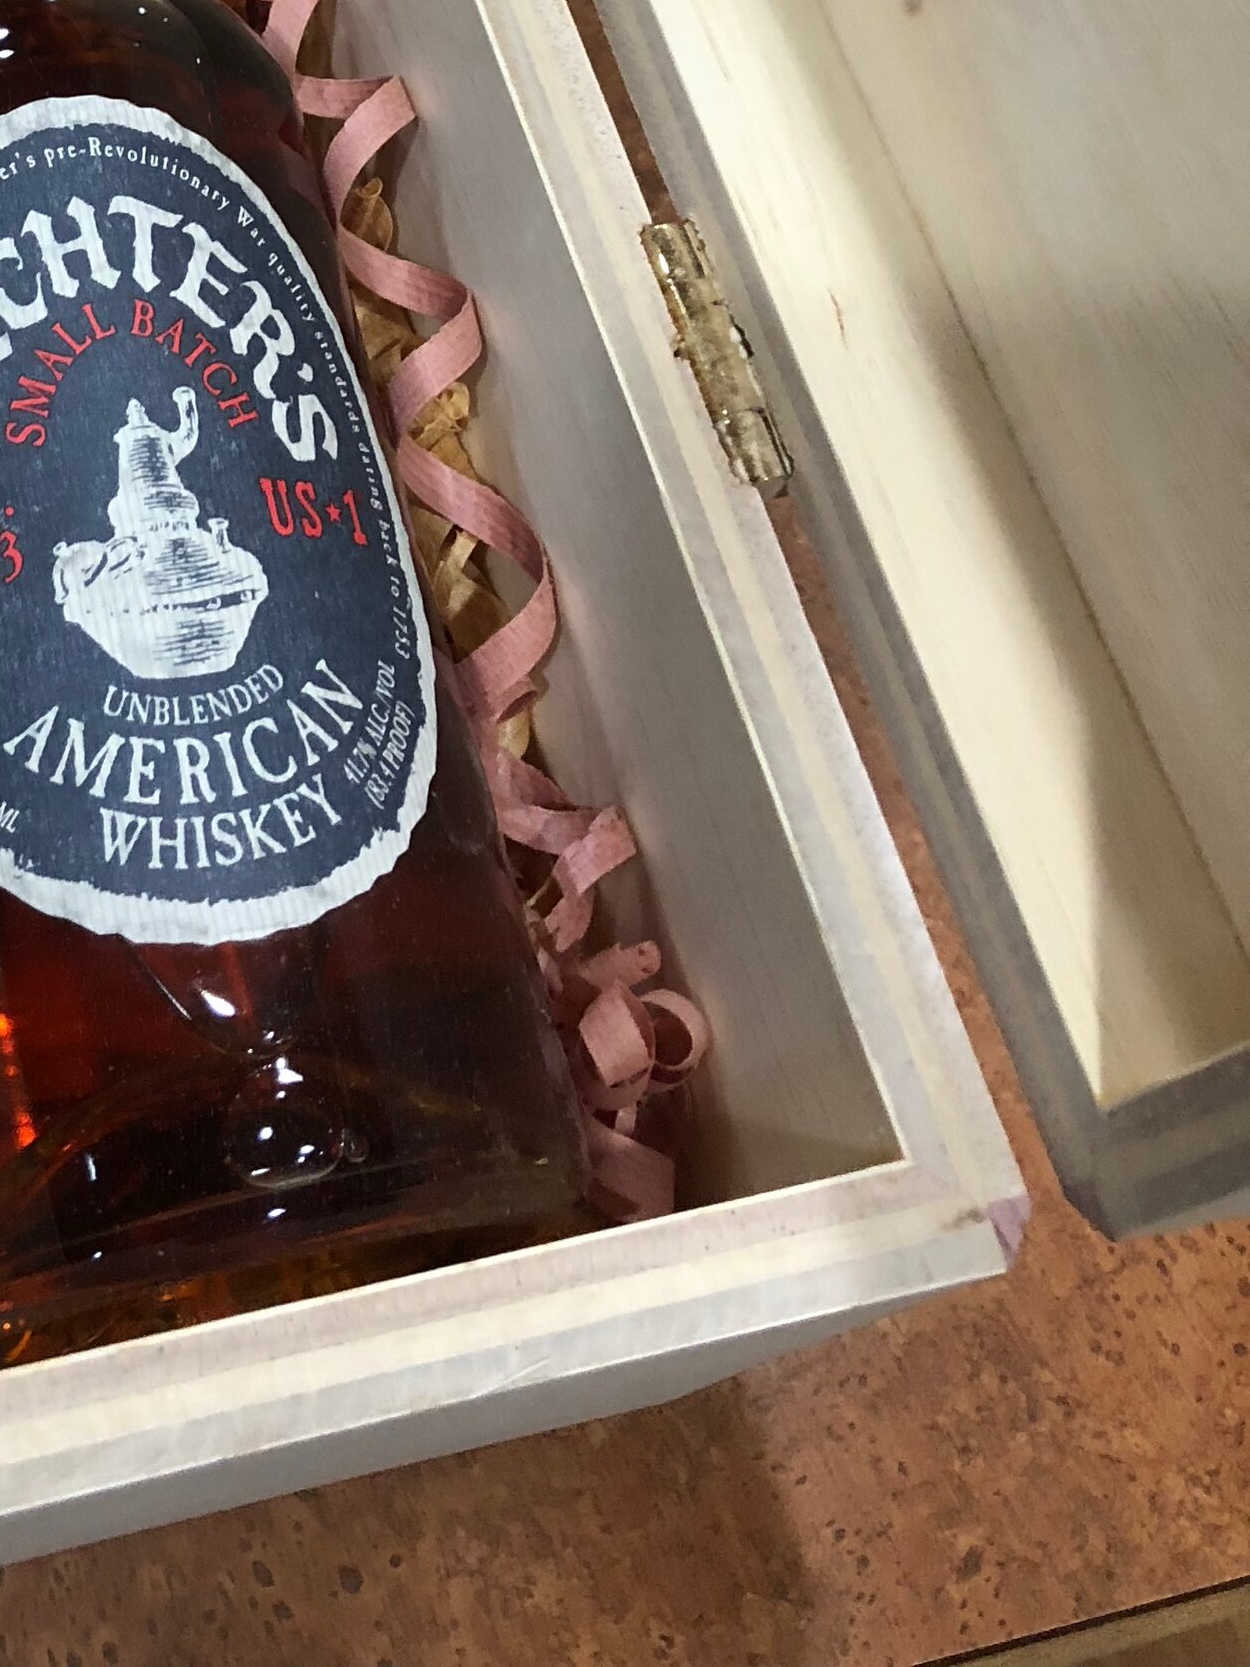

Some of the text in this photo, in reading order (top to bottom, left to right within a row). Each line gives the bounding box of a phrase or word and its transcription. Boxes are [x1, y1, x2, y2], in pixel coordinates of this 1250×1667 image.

[43, 135, 231, 212] pre-Revolutionary
[236, 205, 266, 248] War
[267, 251, 317, 324] quality
[6, 296, 259, 448] SMALL BATCH
[314, 329, 361, 434] standards
[357, 440, 385, 511] dating
[378, 518, 398, 568] back
[389, 572, 401, 599] to
[392, 602, 410, 661] 1753
[103, 662, 285, 726] UNBLENDED
[2, 658, 364, 808] AMERICAN
[98, 772, 343, 872] WHISKEY
